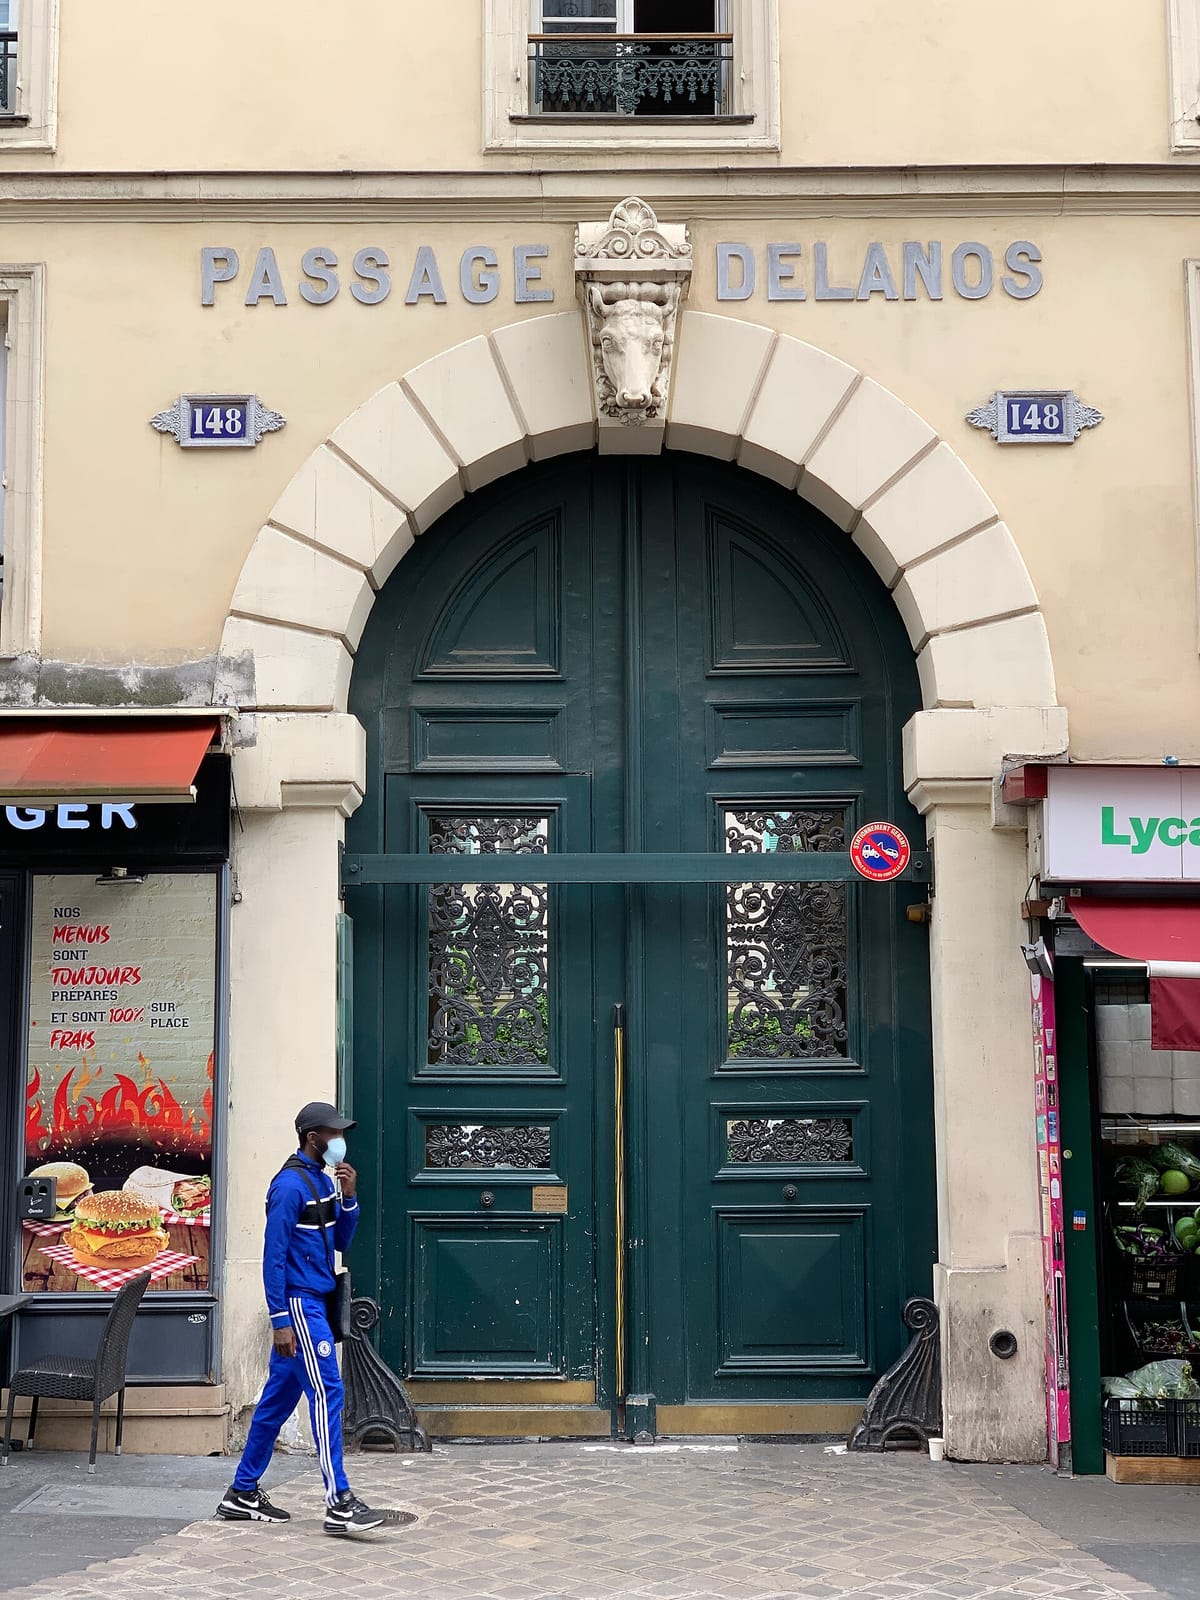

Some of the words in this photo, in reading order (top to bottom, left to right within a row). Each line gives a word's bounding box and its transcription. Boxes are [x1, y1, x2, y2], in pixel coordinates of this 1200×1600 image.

[201, 244, 554, 307] PASSAGE
[716, 240, 1044, 302] DELANOS
[193, 407, 242, 435] 148
[1010, 403, 1060, 430] 148
[852, 824, 891, 850] STATIONNEMENT
[53, 907, 81, 918] NOS
[52, 924, 111, 945] MENUS
[53, 950, 88, 961] SONT
[51, 966, 142, 986] TOUJOURS
[51, 986, 118, 1001] PRÉPARÉS
[51, 1012, 67, 1023] ET
[72, 1012, 106, 1022] SONT
[109, 1007, 145, 1023] 100%
[151, 1002, 175, 1012] SUR
[150, 1018, 189, 1028] PLACE
[50, 1029, 96, 1050] FRAIS
